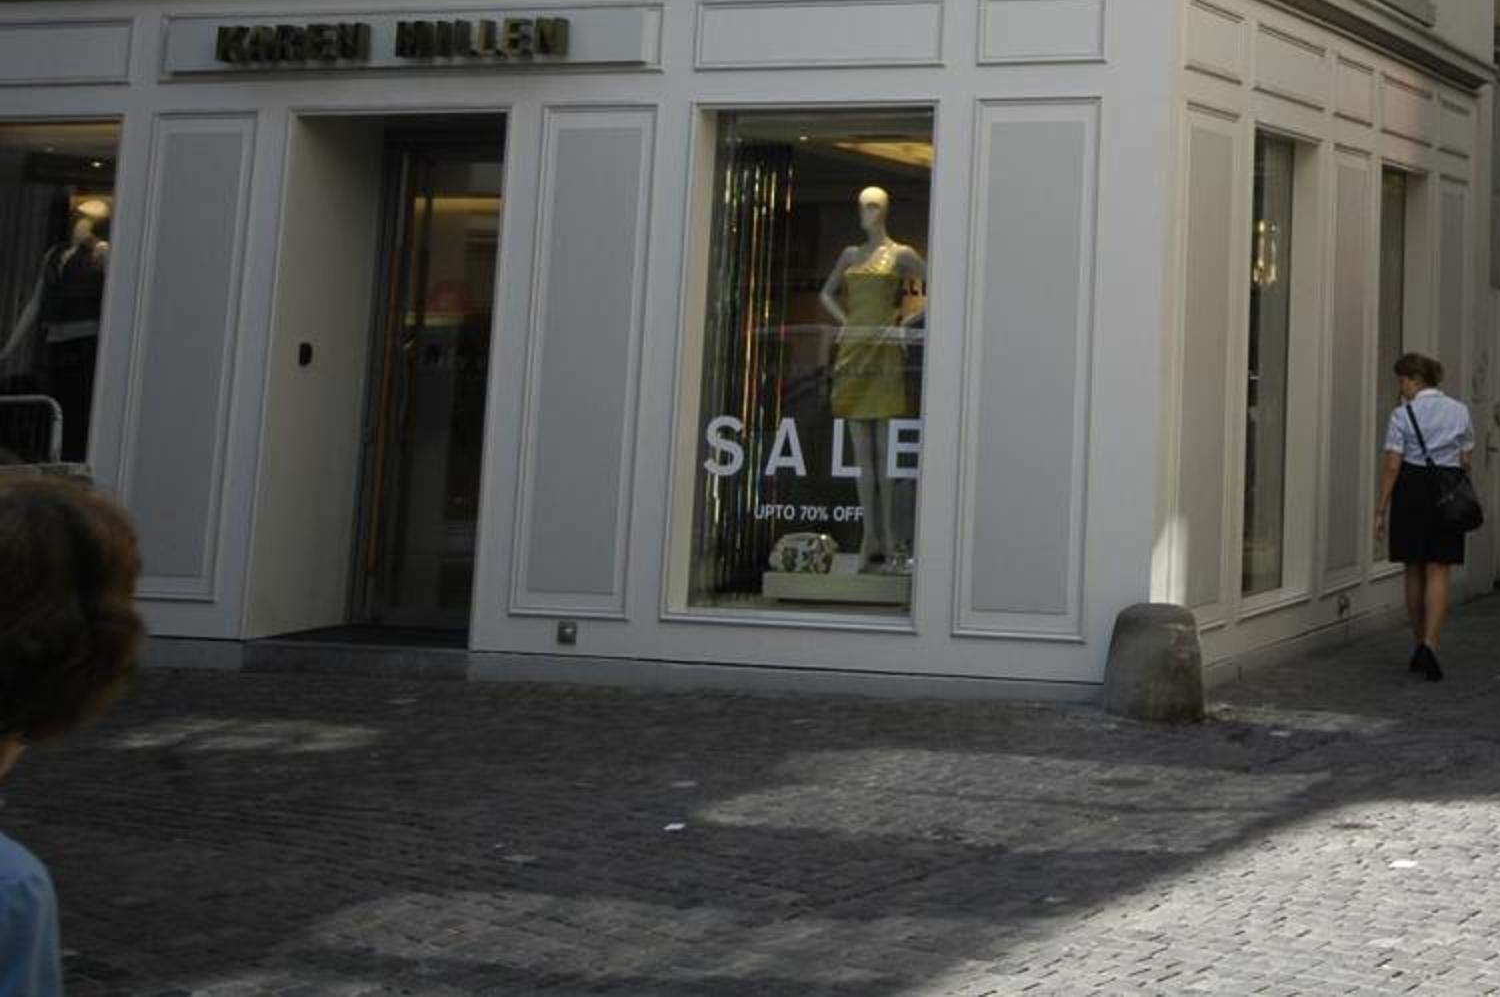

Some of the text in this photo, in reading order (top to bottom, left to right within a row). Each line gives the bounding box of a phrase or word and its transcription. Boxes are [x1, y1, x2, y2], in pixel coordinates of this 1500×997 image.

[215, 17, 571, 63] KAREN MILLEN
[703, 415, 924, 479] SALE
[753, 504, 865, 522] UPTO 70% OFF
